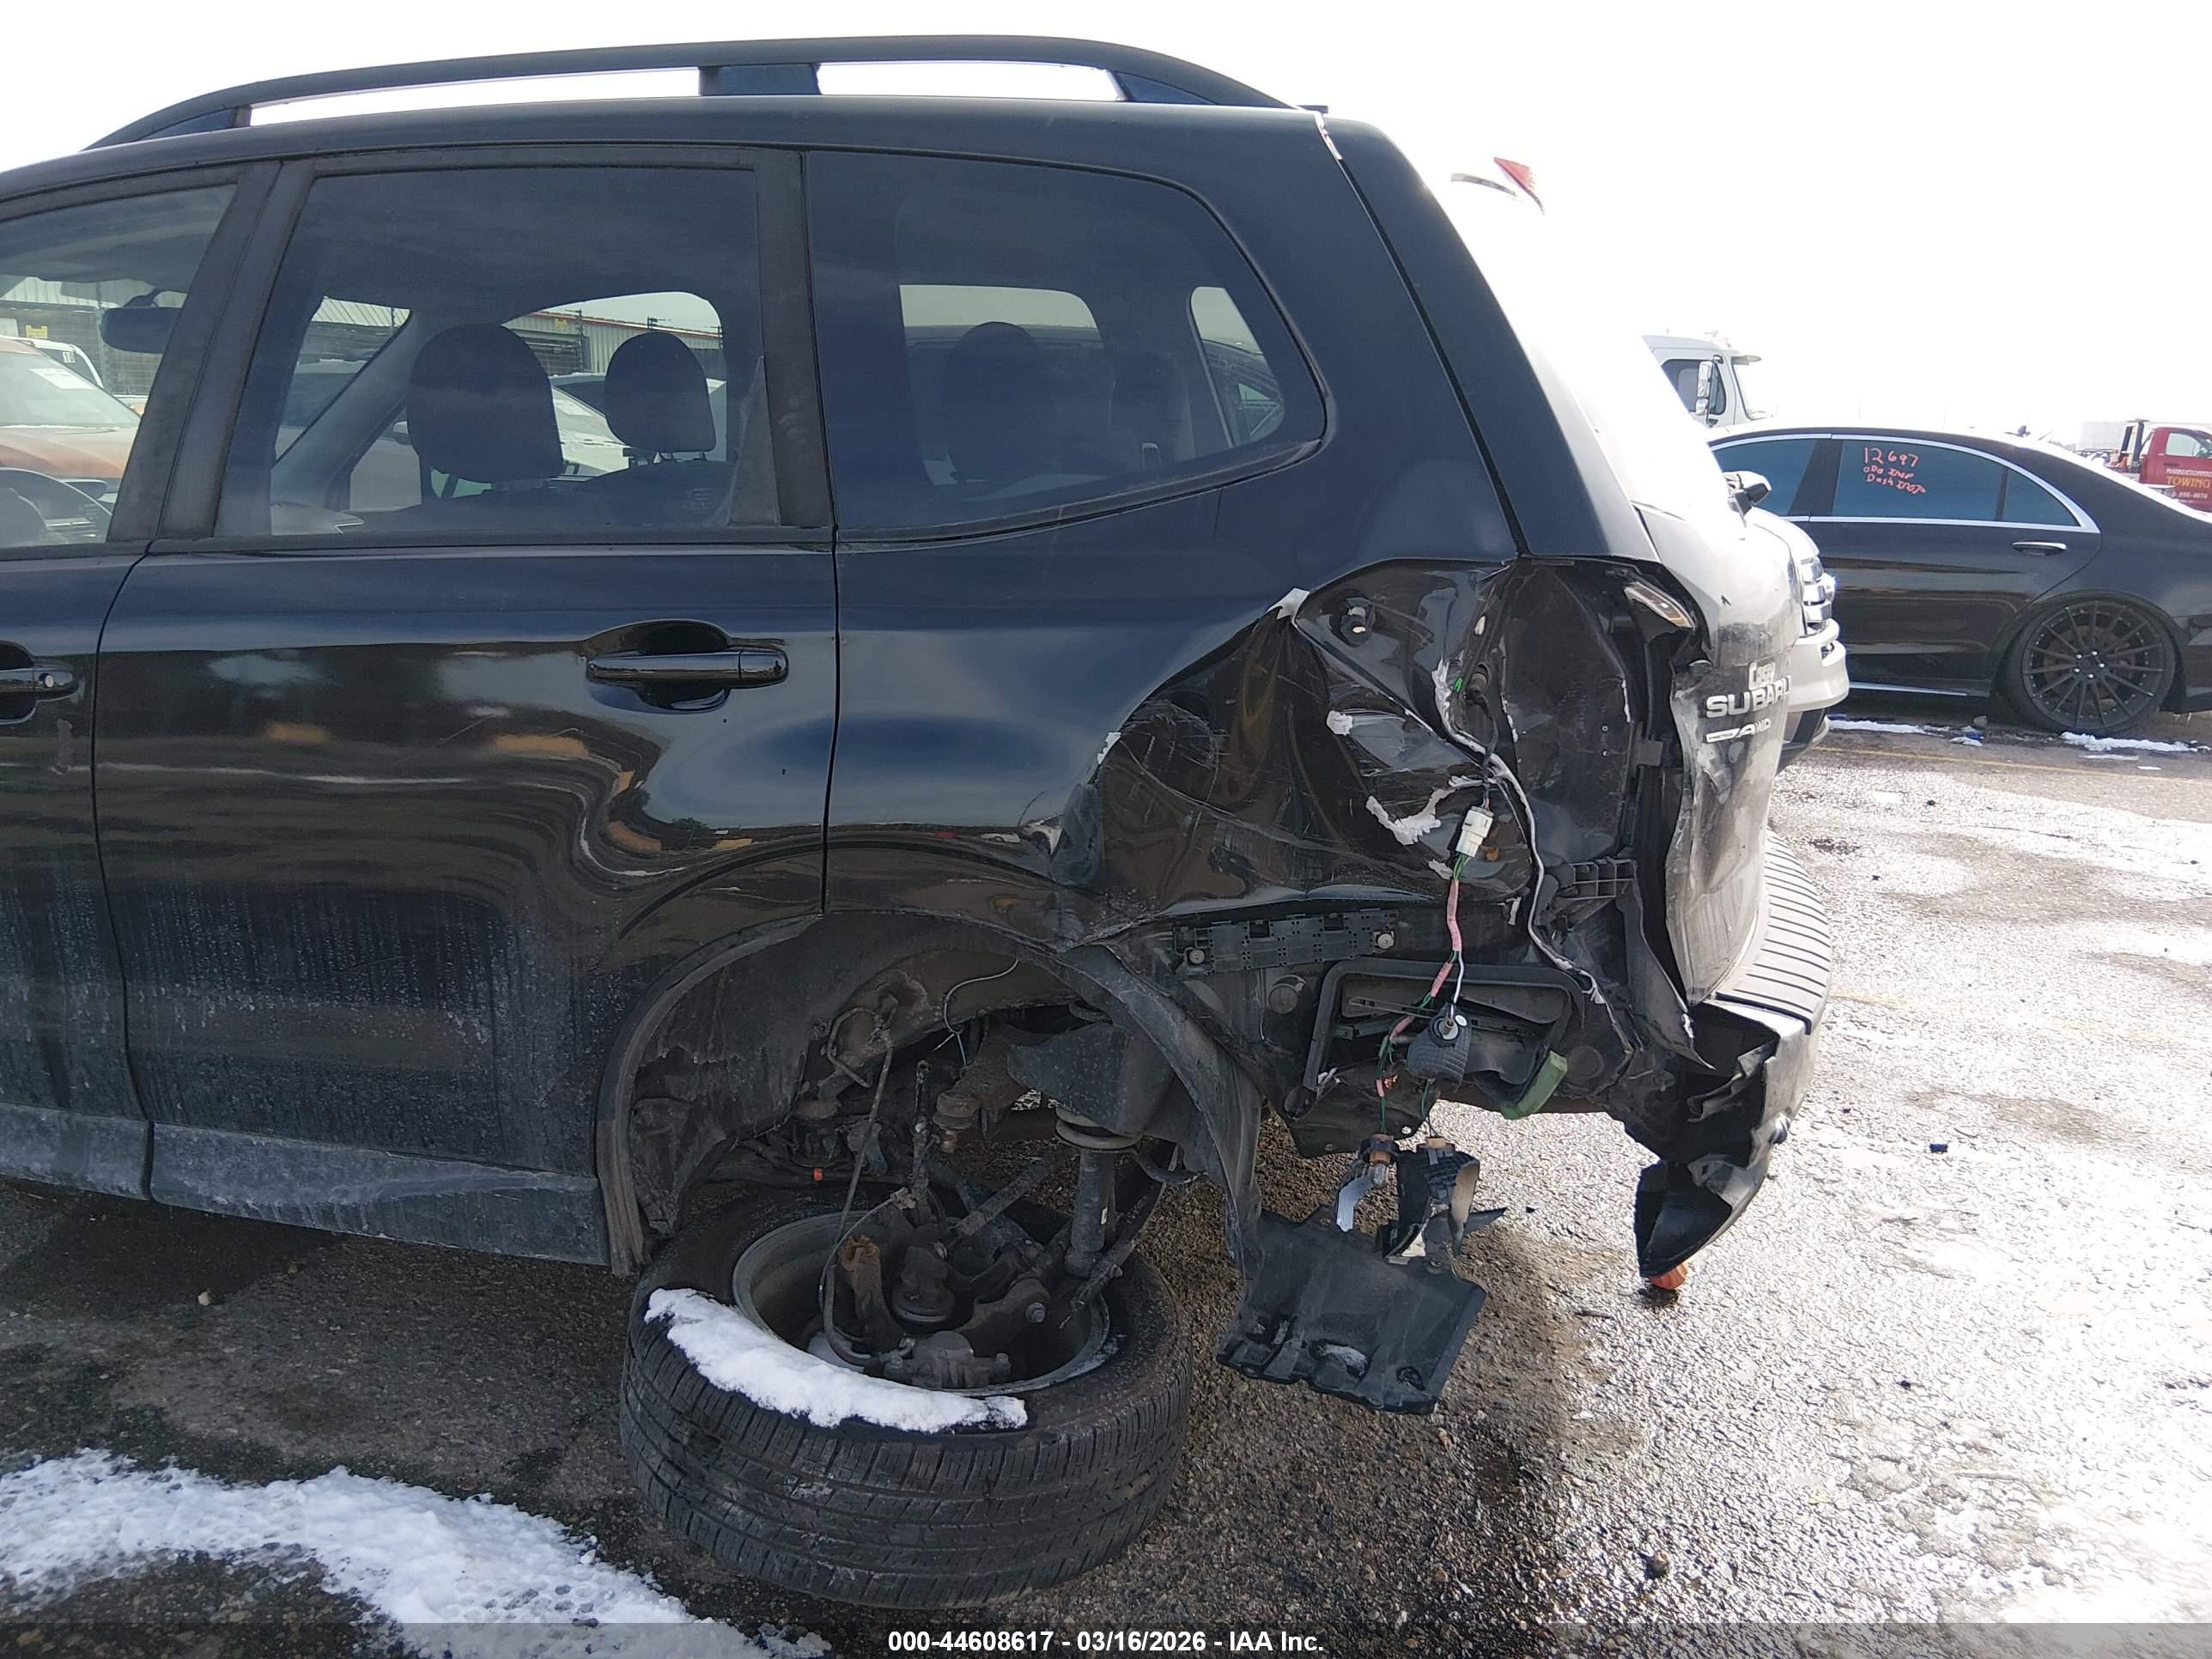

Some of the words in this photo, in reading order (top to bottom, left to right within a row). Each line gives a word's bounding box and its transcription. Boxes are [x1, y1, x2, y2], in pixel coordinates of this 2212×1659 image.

[2166, 476, 2211, 489] TOWING
[1706, 675, 1791, 719] SUBARU
[1735, 718, 1771, 738] AWD
